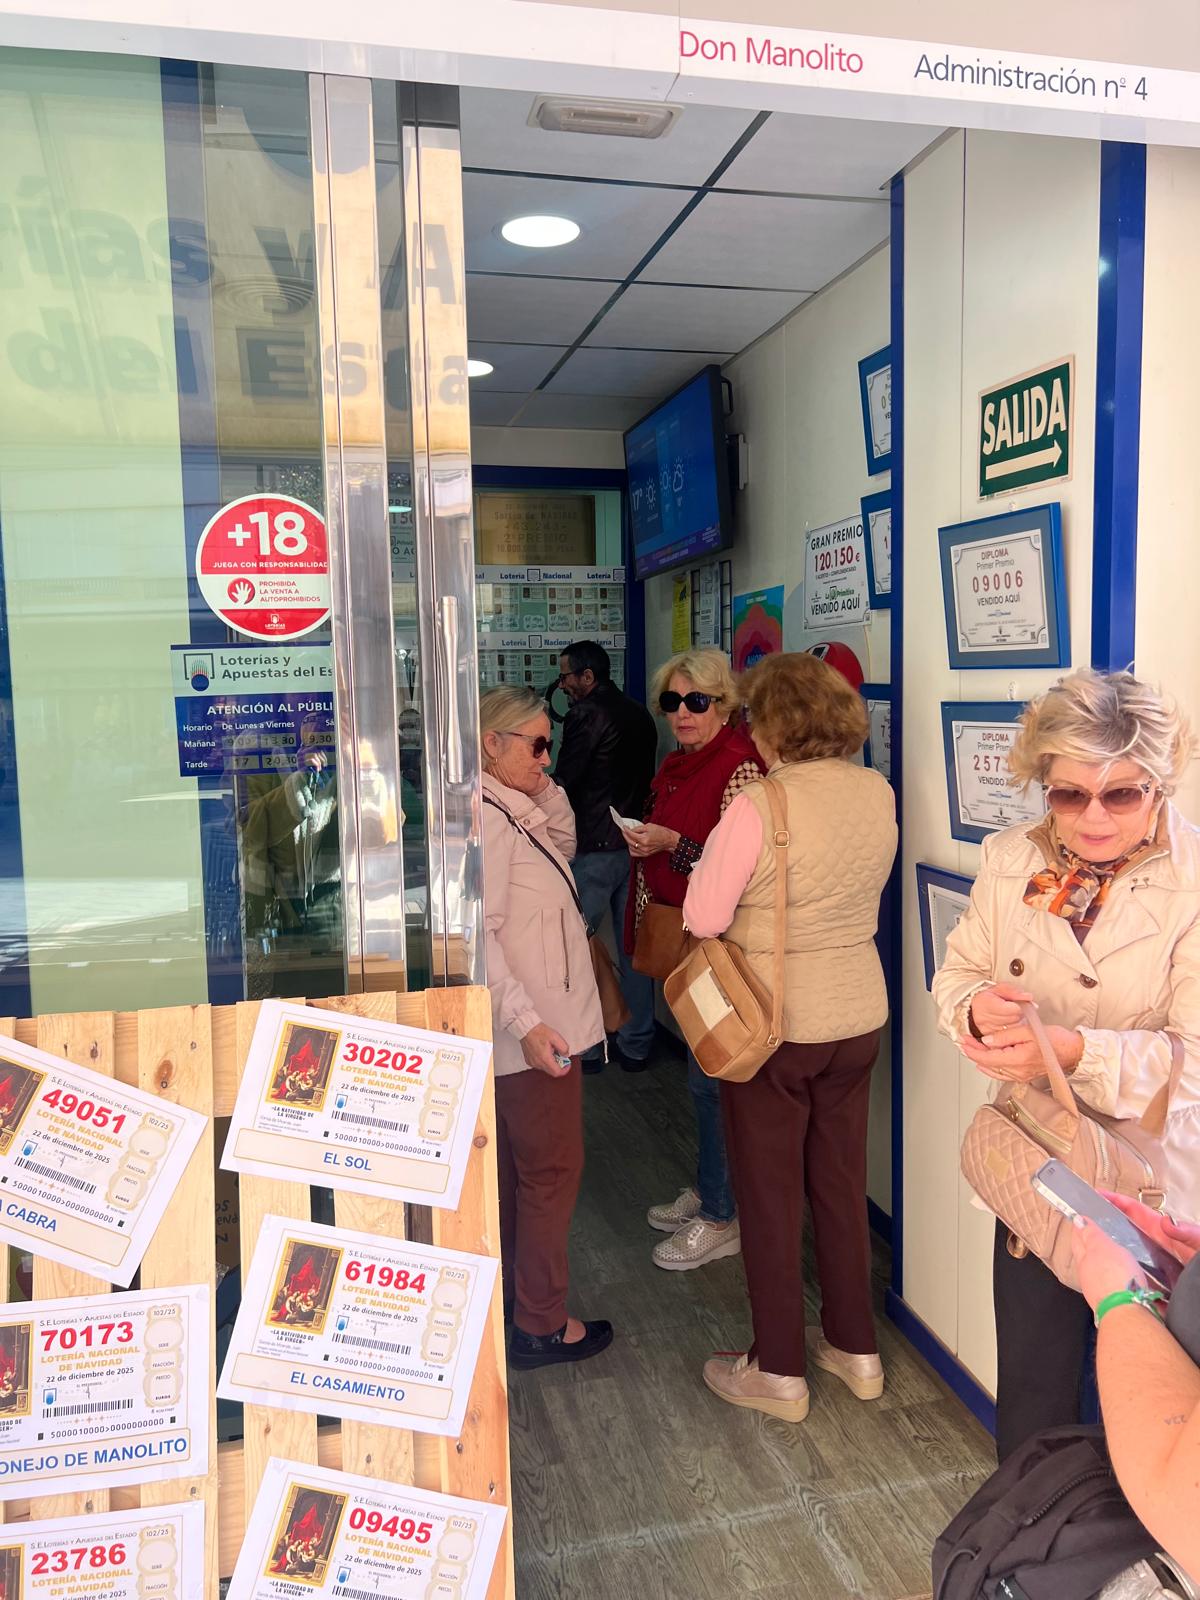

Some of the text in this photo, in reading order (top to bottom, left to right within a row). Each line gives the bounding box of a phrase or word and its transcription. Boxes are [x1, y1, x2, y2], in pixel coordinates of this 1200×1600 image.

[680, 31, 863, 73] Don Manolito
[914, 54, 1096, 97] Administración
[1134, 77, 1148, 100] 4
[982, 377, 1067, 456] SALIDA
[227, 511, 308, 556] +18
[811, 533, 831, 550] GRAN
[832, 524, 863, 544] PREMIO
[814, 545, 860, 572] 120.150 €
[981, 547, 1009, 560] DIPLOMA
[976, 559, 1014, 571] Primer Premio
[811, 593, 860, 616] VENDIDO AQUÍ
[976, 592, 1021, 607] VENDIDO AQUÍ
[543, 639, 573, 647] Nacional
[220, 653, 291, 667] Loterías y
[222, 668, 289, 681] Apuestas
[293, 666, 315, 677] del
[207, 701, 274, 715] ATENCIÓN
[278, 703, 295, 713] AL
[235, 722, 258, 730] Lunes
[266, 721, 295, 729] Viernes
[184, 740, 216, 748] Mañana
[977, 742, 995, 750] Primer
[982, 733, 1009, 742] DIPLOMA
[185, 761, 208, 769] Tarde
[978, 776, 1005, 787] VENDIDO
[342, 1042, 423, 1075] 30202
[340, 1064, 424, 1086] LOTERÍA NACIONAL
[359, 1087, 389, 1098] diciembre
[400, 1094, 416, 1103] 2025
[368, 1079, 407, 1092] NAVIDAD
[42, 1089, 127, 1134] 49051
[36, 1109, 123, 1149] LOTERÍA NACIONAL
[47, 1124, 104, 1151] DE NAVIDAD
[32, 1129, 111, 1164] 22 de diciembre de 2025
[323, 1152, 373, 1171] EL SOL
[6, 1203, 58, 1232] CABRA
[345, 1260, 426, 1294] 61984
[341, 1284, 427, 1306] LOTERÍA NACIONAL
[355, 1296, 410, 1313] DE NAVIDAD
[351, 1305, 360, 1313] de
[361, 1307, 392, 1319] diciembre
[393, 1312, 402, 1320] de
[402, 1315, 418, 1323] 2025
[40, 1321, 134, 1351] 70173
[40, 1346, 141, 1364] LOTERÍA NACIONAL
[58, 1357, 123, 1372] DE NAVIDAD
[46, 1366, 134, 1383] 22 de diciembre de 2025
[290, 1371, 405, 1402] EL CASAMIENTO
[64, 1452, 88, 1467] DE
[94, 1437, 187, 1464] MANOLITO
[349, 1507, 433, 1543] 09495
[345, 1533, 432, 1558] LOTERÍA NACIONAL
[358, 1546, 415, 1564] DE NAVIDAD
[31, 1543, 126, 1575] 23786
[344, 1554, 353, 1562] 22
[354, 1556, 363, 1564] de
[363, 1558, 396, 1571] diciembre
[406, 1566, 422, 1576] 2025
[32, 1568, 133, 1588] LOTERÍA NACIONAL
[50, 1581, 115, 1596] DE NAVIDAD
[98, 1590, 127, 1600] de 2025
